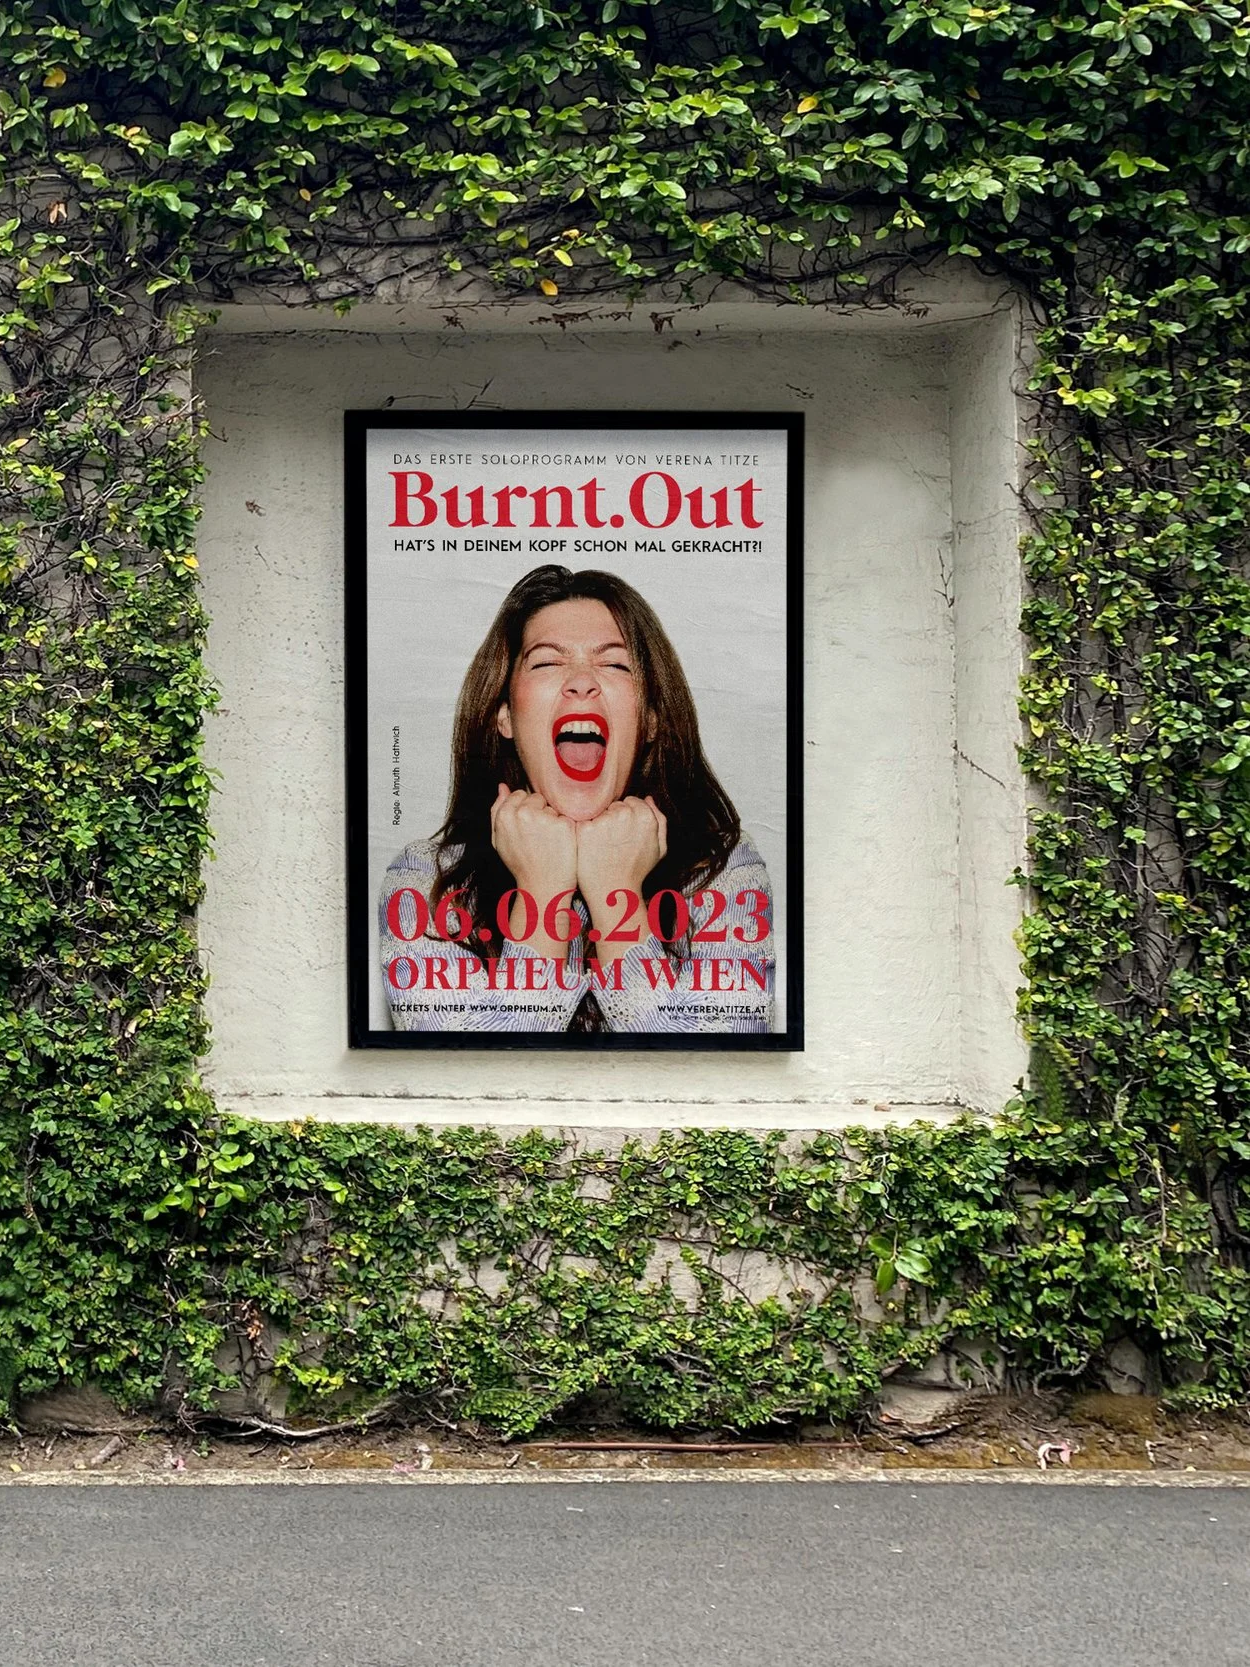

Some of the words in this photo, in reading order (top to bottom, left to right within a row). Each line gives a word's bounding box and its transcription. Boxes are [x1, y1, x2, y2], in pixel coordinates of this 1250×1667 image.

[393, 454, 421, 465] DAS
[430, 454, 472, 465] ERSTE
[481, 454, 607, 466] SOLOPROGRAMM
[616, 454, 647, 466] VON
[655, 454, 713, 466] VERENA
[720, 454, 759, 467] TITZE
[388, 470, 764, 529] Burnt.Out
[394, 538, 435, 552] HAT'S
[442, 539, 457, 552] IN
[464, 539, 522, 552] DEINEM
[528, 539, 567, 552] KOPF
[574, 539, 627, 552] SCHON
[634, 540, 666, 553] MAL
[671, 540, 762, 553] GEKRACHT?!
[392, 725, 400, 763] Hattwich
[392, 767, 400, 797] Almuth
[387, 887, 771, 943] 06.06.2023
[387, 956, 629, 991] ORPHEUM
[638, 957, 768, 992] WIEN
[391, 1004, 430, 1012] TICKETS
[433, 1004, 466, 1012] UNTER
[470, 1004, 563, 1013] WWW.ORPHEUM.AT
[657, 1005, 767, 1014] WWW.VERENATITZE.AT
